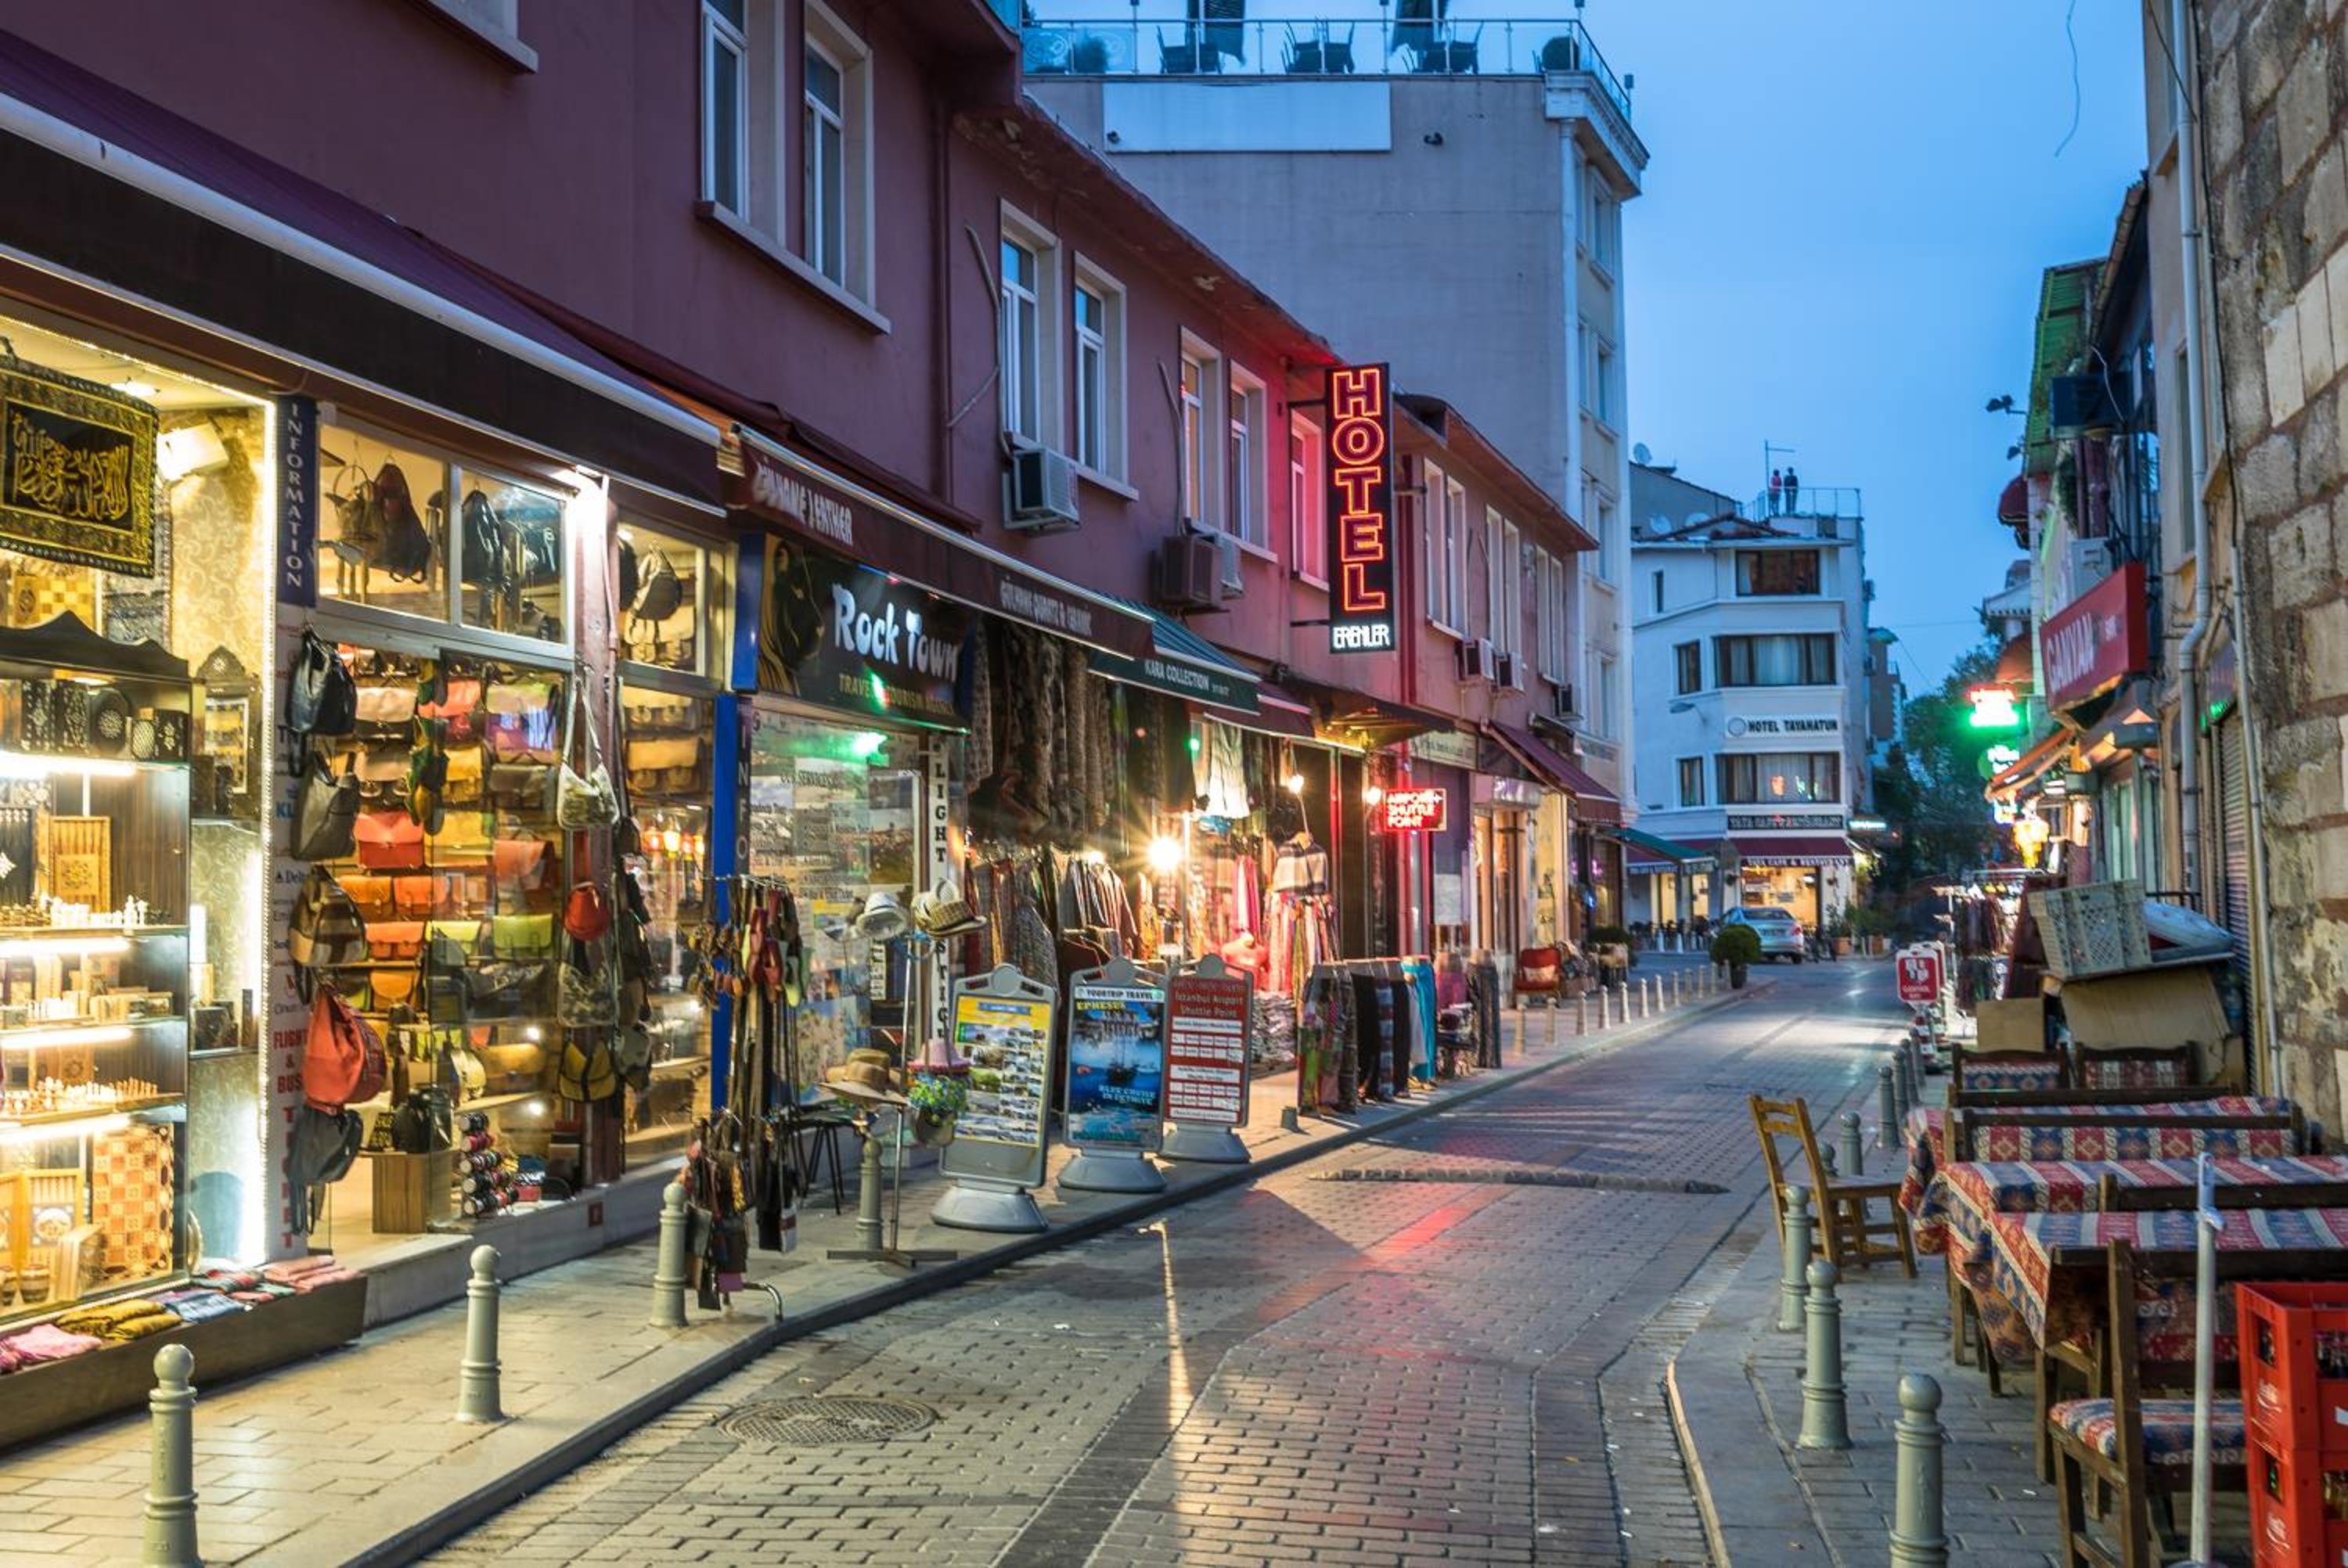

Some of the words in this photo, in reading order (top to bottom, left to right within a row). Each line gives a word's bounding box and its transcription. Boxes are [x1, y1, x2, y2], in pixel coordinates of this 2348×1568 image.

[286, 402, 304, 587] INFORMATION
[1333, 368, 1385, 611] HOTEL
[807, 488, 853, 548] LEATHER
[832, 582, 900, 665] Rock
[840, 674, 877, 699] TRAVE
[1165, 664, 1209, 690] COLLECTION
[1748, 719, 1779, 732] HOTEL
[736, 725, 749, 860] INFO
[276, 801, 294, 818] KL
[1388, 802, 1434, 816] SHUTTLE
[1388, 815, 1423, 828] POINT
[274, 1028, 308, 1048] FLIGHT
[285, 1055, 295, 1068] &
[277, 1076, 303, 1093] BUS
